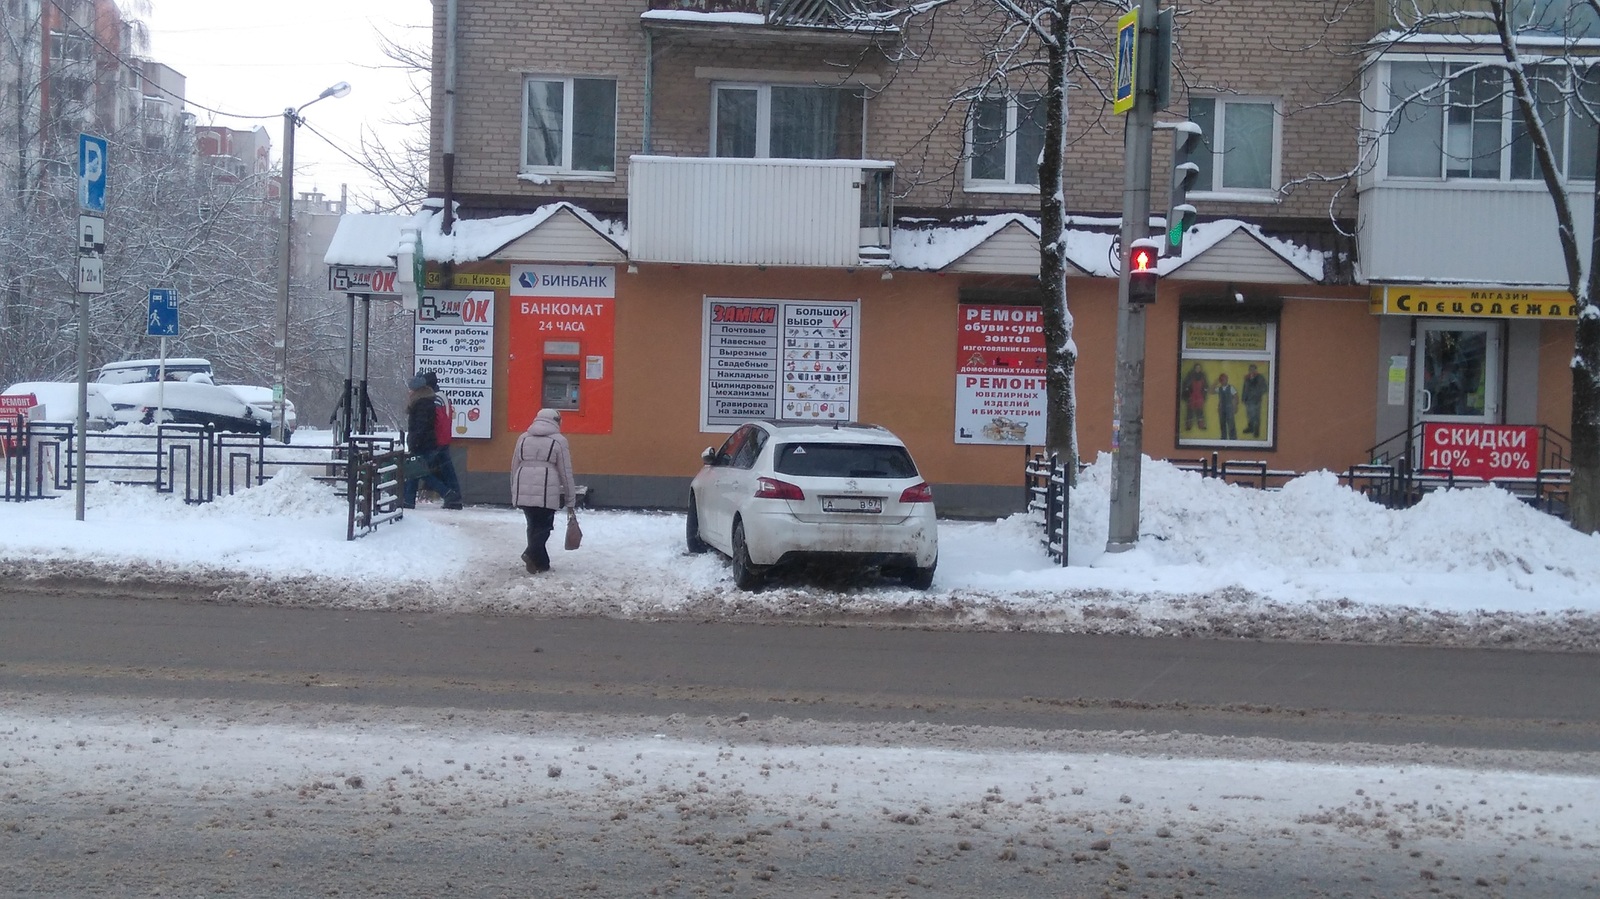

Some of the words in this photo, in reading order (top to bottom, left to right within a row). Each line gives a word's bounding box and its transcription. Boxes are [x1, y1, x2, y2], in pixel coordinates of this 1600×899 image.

[428, 273, 440, 283] 34
[542, 275, 608, 288] БИНБАНК
[1471, 291, 1529, 301] МАГАЗИН
[520, 302, 604, 317] БАНКОМАТ
[795, 308, 848, 317] БОЛЬШОЙ
[713, 305, 777, 324] ЗАМКИ
[967, 309, 1043, 322] РЕМОН
[538, 321, 553, 331] 24
[556, 321, 586, 332] ЧАСА
[787, 318, 823, 326] ВЫБОР
[420, 327, 452, 335] Режим
[454, 328, 489, 336] работы
[721, 326, 766, 335] Почтовые
[964, 323, 1004, 334] обуви
[720, 338, 766, 346] Навесные
[985, 335, 1030, 343] зонтов
[719, 349, 767, 357] Вырезные
[419, 359, 488, 367] WhatsApp/Viber
[717, 360, 769, 368] Свадебные
[961, 366, 1015, 374] ДОМОФОННЫХ
[717, 371, 769, 380] Накладные
[711, 382, 774, 391] Цилиндровые
[966, 377, 1047, 390] РЕМОНТ
[975, 391, 1039, 399] ЮВЕЛИРНЫХ
[715, 400, 768, 409] Гравировка
[984, 400, 1030, 408] ИЗДЕЛИЙ
[980, 409, 1041, 417] БИЖУТЕРИИ
[1434, 428, 1526, 449] СКИДКИ
[1430, 449, 1470, 467] 10%
[1489, 451, 1530, 470] 30%
